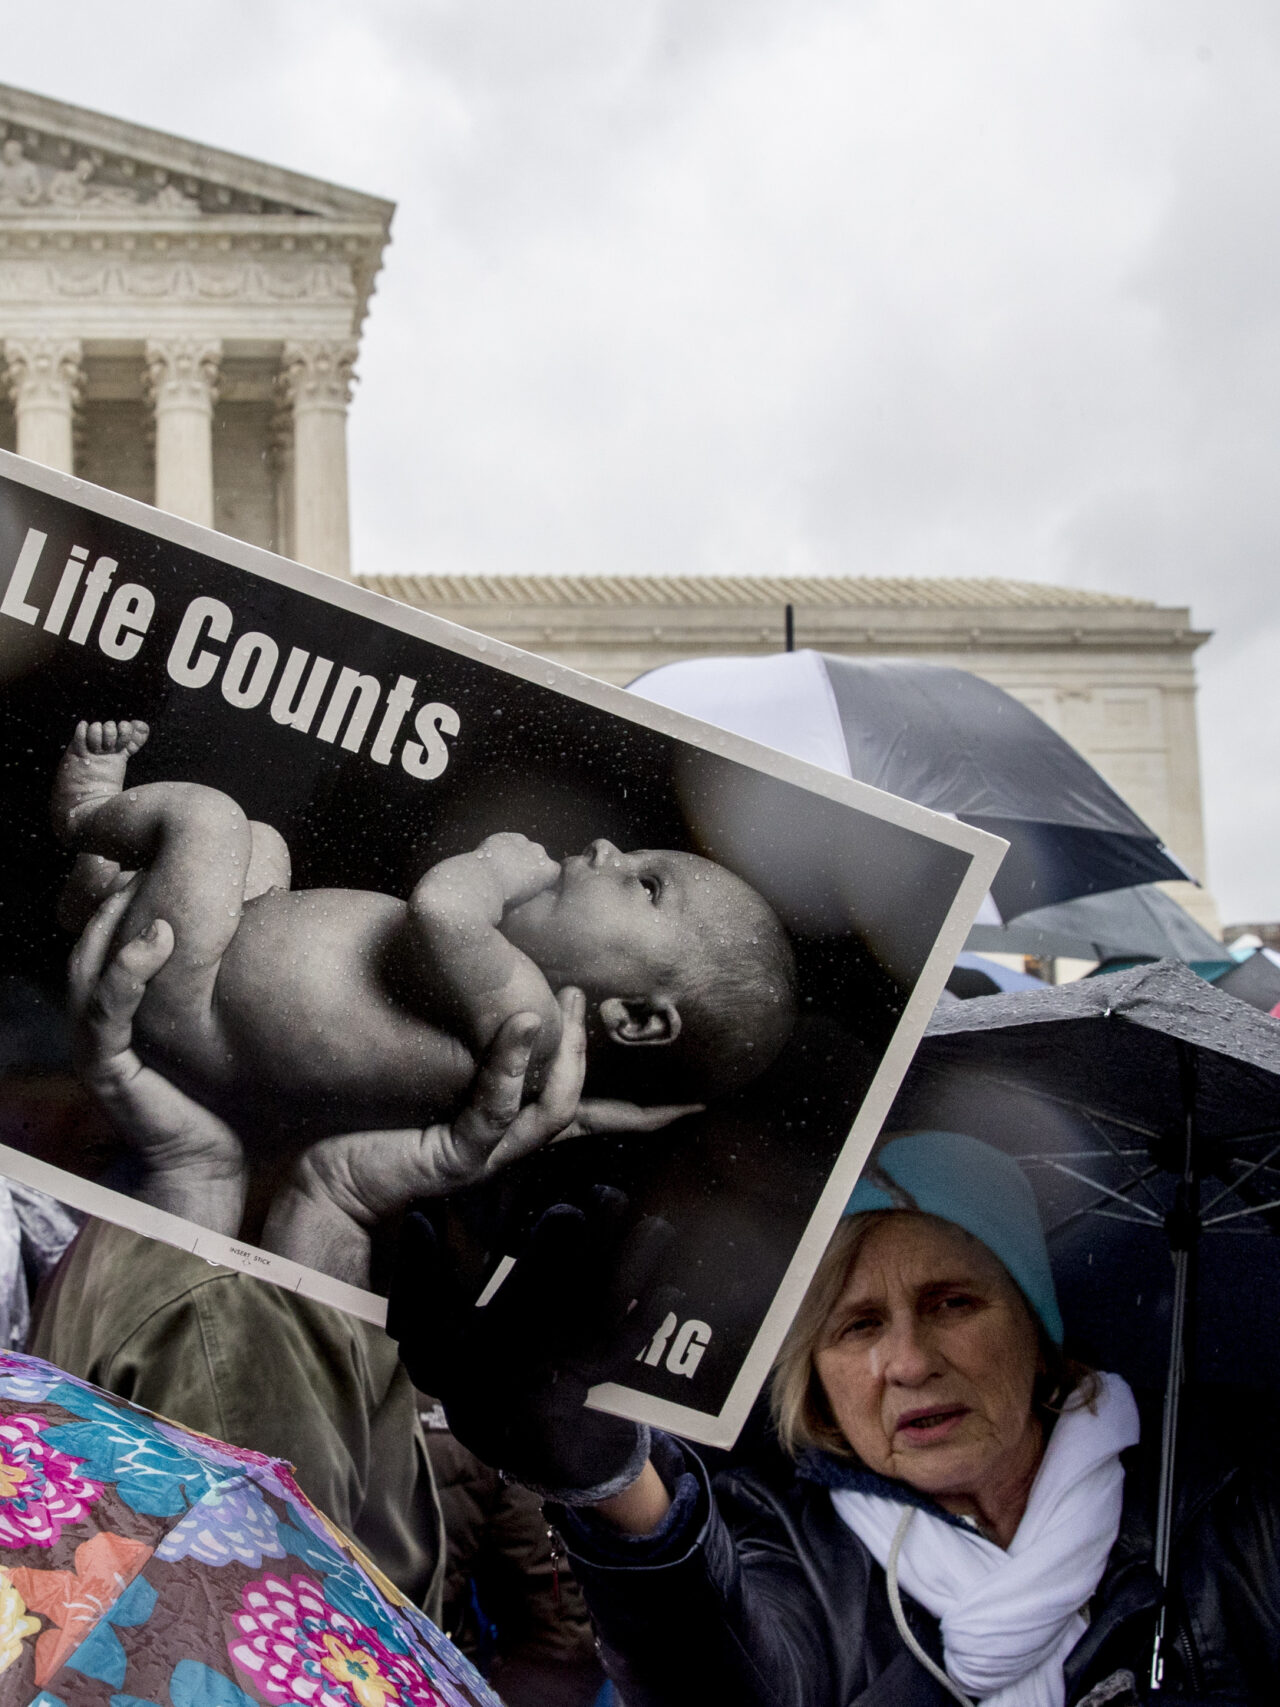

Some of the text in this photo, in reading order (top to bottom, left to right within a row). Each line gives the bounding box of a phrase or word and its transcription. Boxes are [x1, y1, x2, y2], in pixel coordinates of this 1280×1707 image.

[0, 527, 461, 781] Life Counts
[230, 1246, 271, 1265] INSERT STICK
